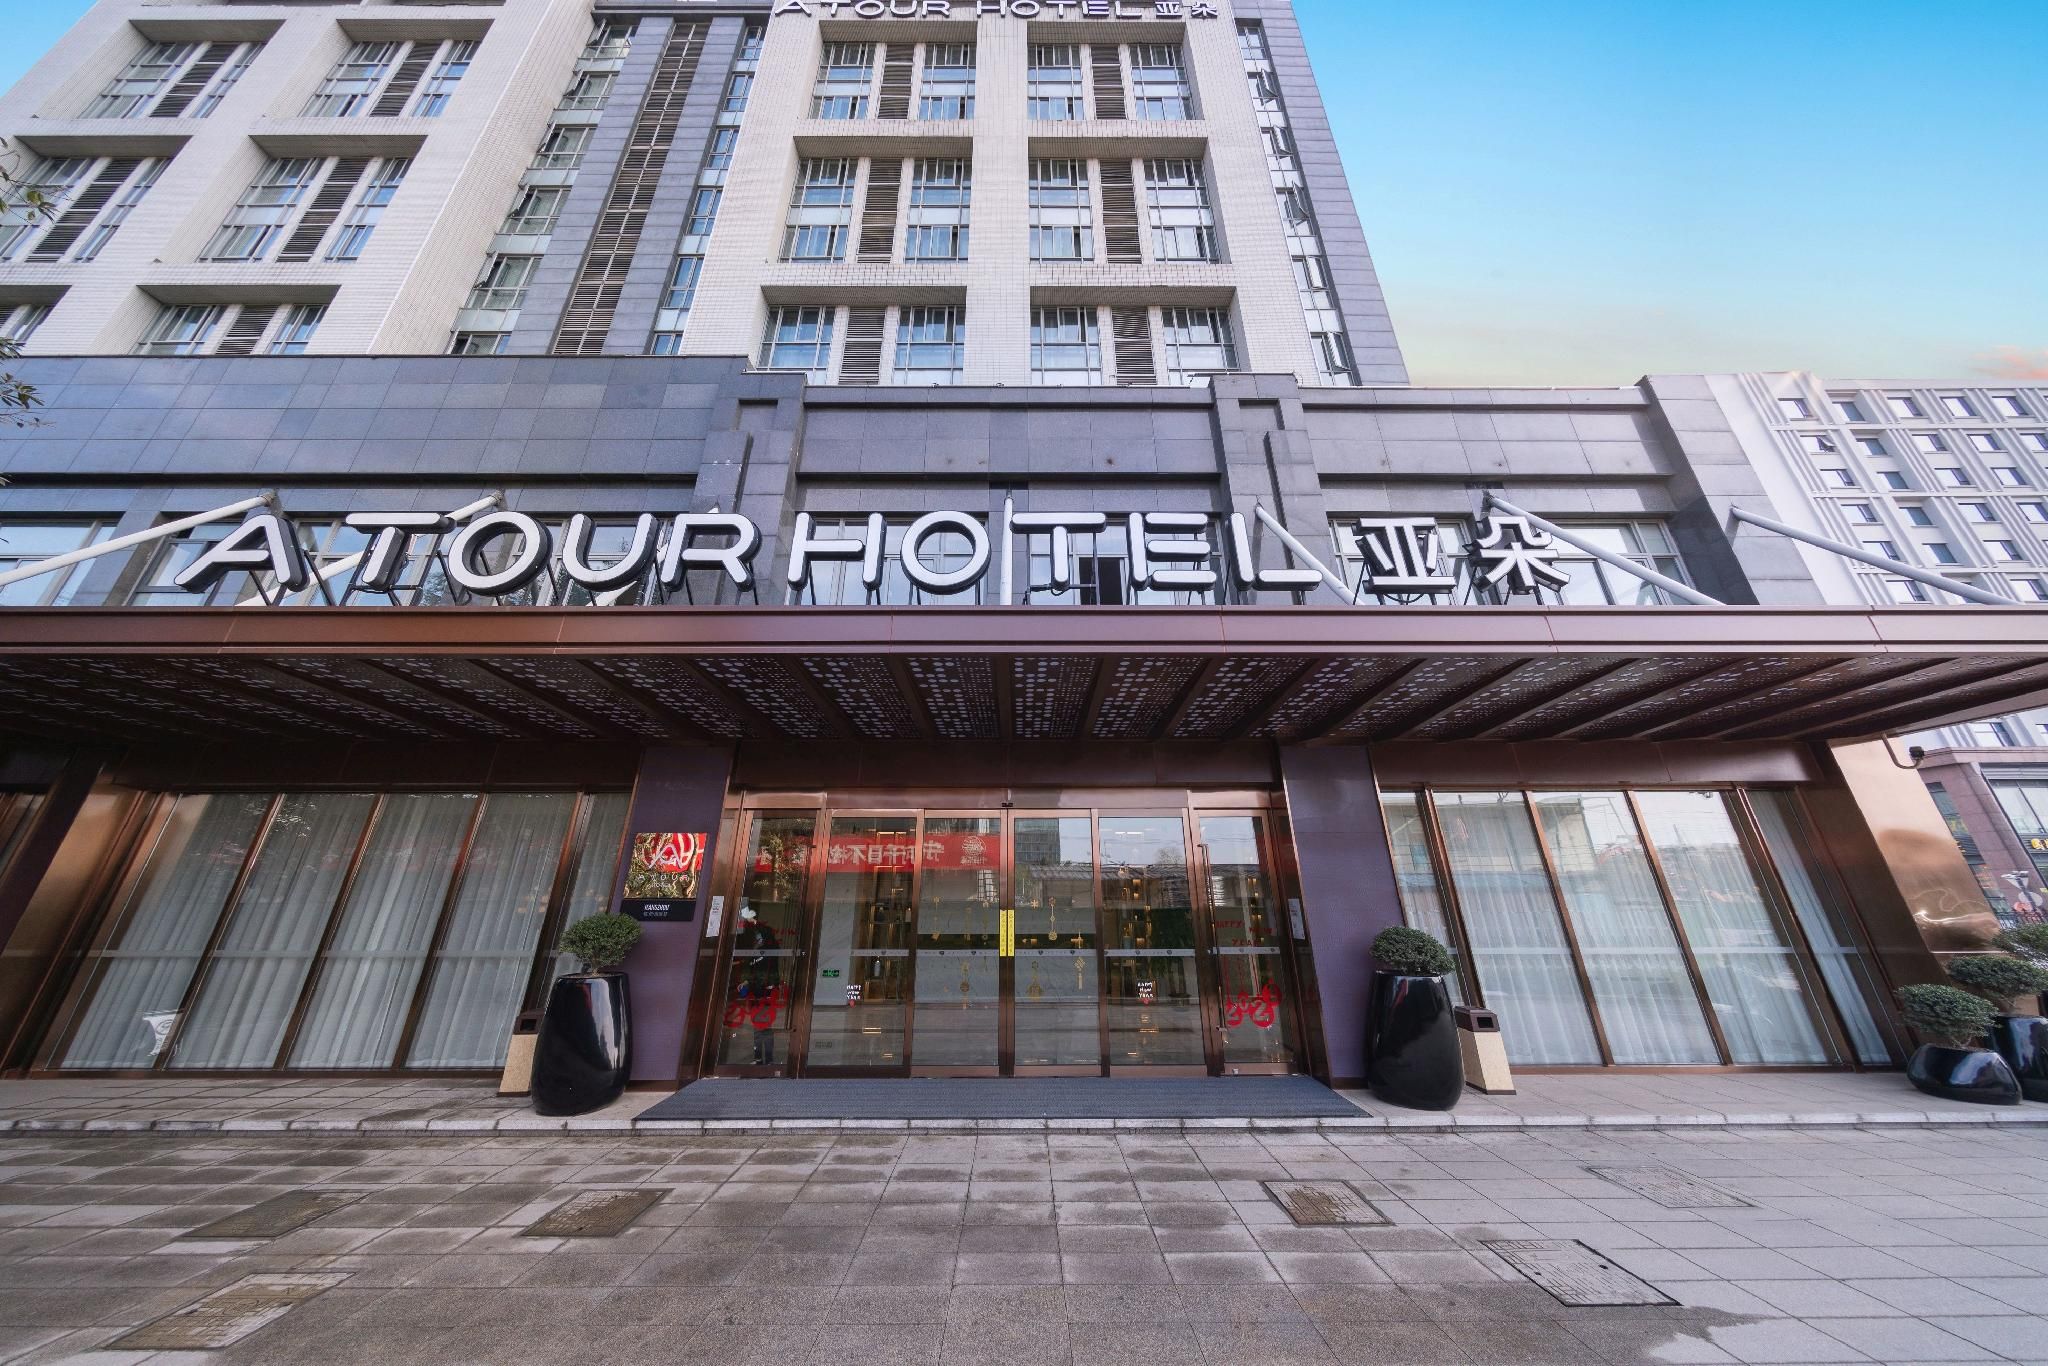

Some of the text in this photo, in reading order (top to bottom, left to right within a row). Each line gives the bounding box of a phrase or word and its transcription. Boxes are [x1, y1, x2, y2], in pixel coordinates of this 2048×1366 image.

[775, 0, 1142, 18] ATOUR HOTEL
[1155, 0, 1218, 19] 亚朵
[174, 510, 1323, 597] ATOUR HOTEL
[1354, 514, 1572, 596] 亚朵
